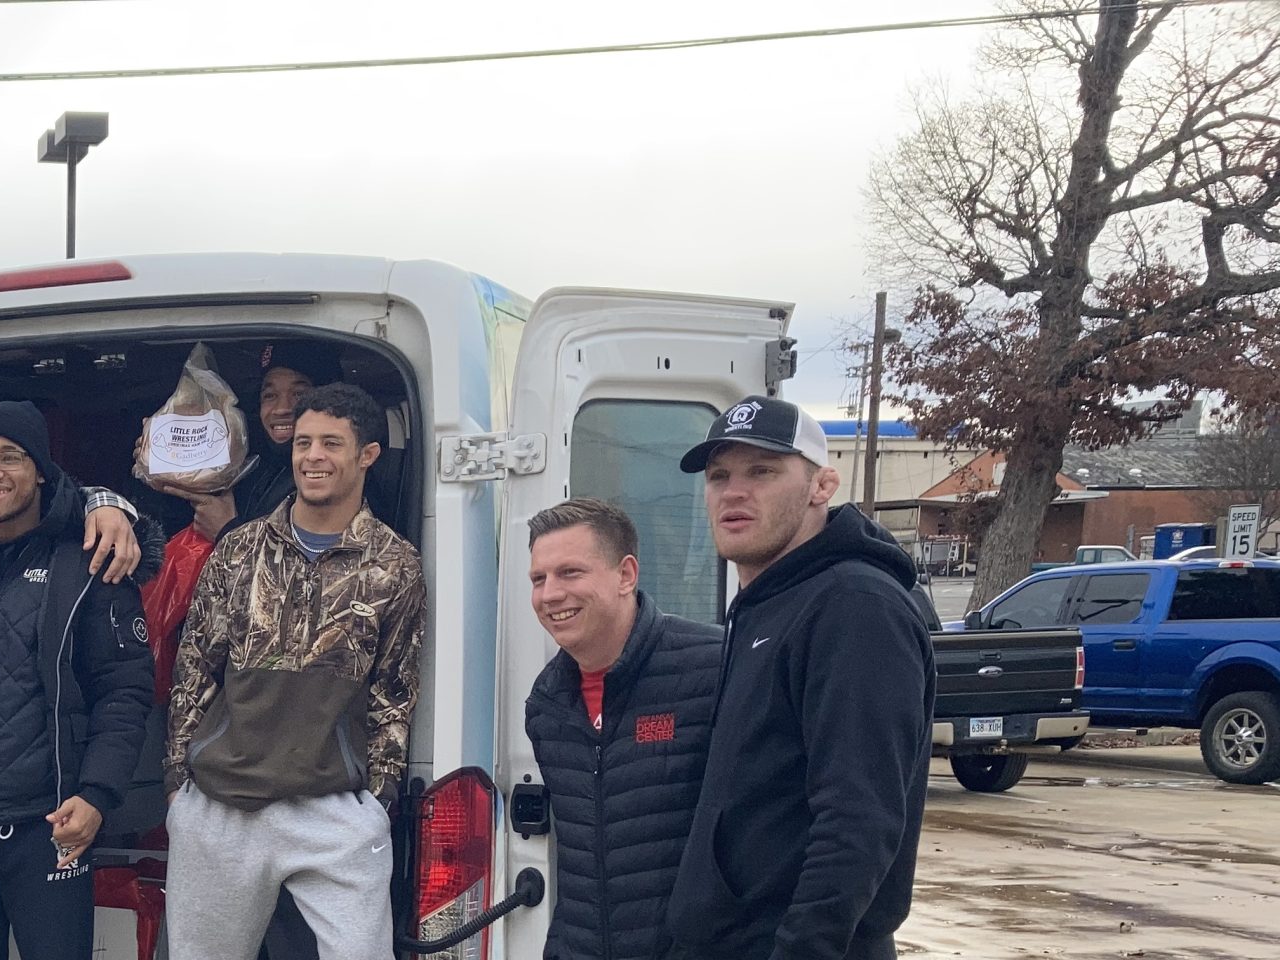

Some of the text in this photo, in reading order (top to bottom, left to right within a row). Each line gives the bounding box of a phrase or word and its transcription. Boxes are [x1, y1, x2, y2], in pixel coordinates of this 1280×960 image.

[170, 424, 208, 435] LITTLE ROCK
[172, 433, 207, 443] WRESTLING
[1232, 512, 1257, 522] SPEED
[1233, 523, 1253, 534] LIMIT
[1232, 535, 1250, 556] 15
[23, 568, 48, 577] LITTLE
[636, 720, 674, 733] DREAM
[971, 723, 1001, 733] 638 XUH
[636, 731, 674, 743] CENTER
[46, 864, 89, 882] WRESTLING
